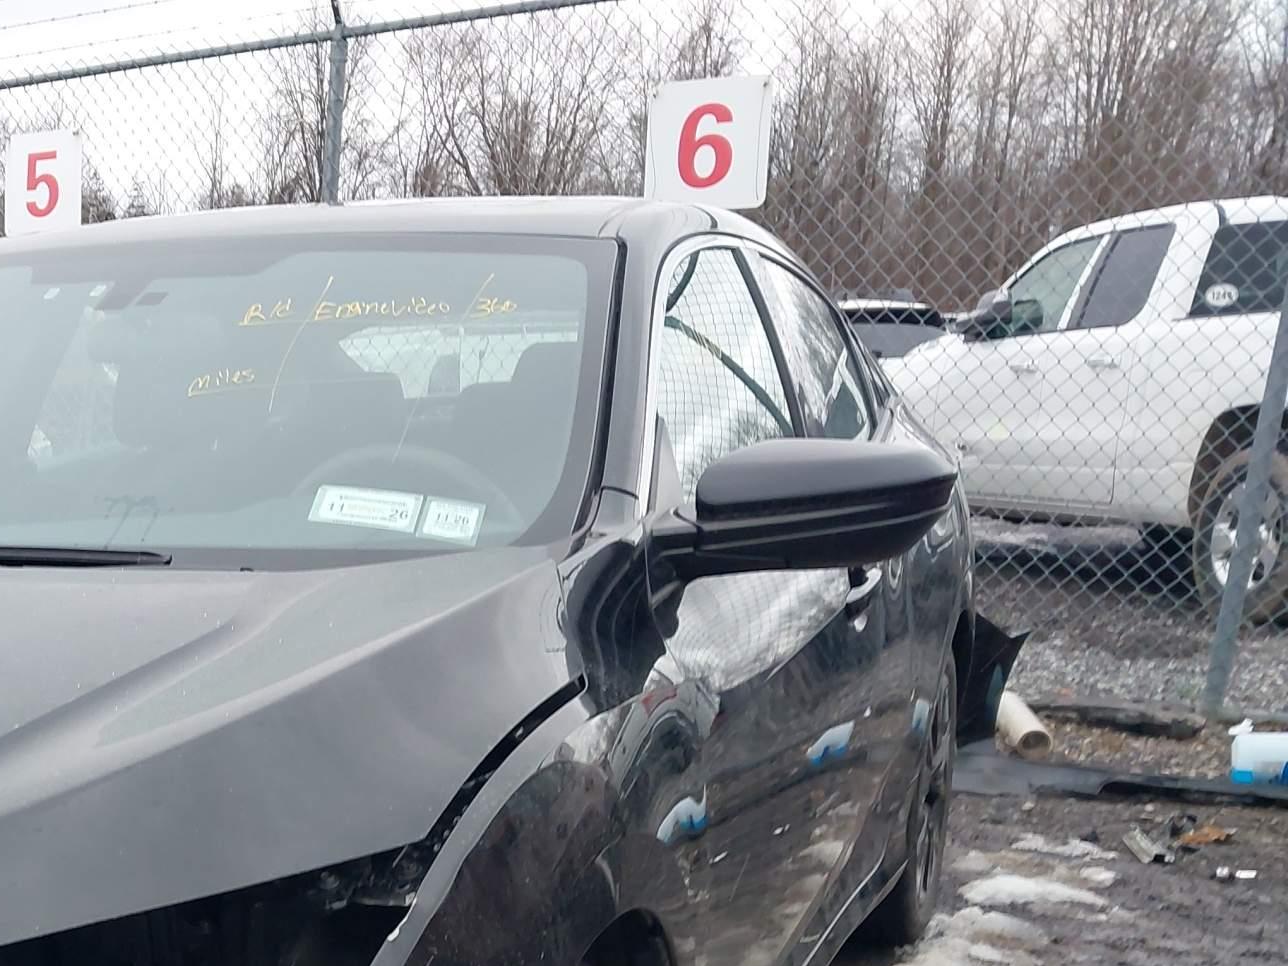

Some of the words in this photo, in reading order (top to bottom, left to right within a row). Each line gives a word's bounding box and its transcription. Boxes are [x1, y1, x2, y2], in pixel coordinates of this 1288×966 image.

[677, 102, 733, 188] 6
[26, 150, 59, 218] 5
[389, 509, 408, 521] 26
